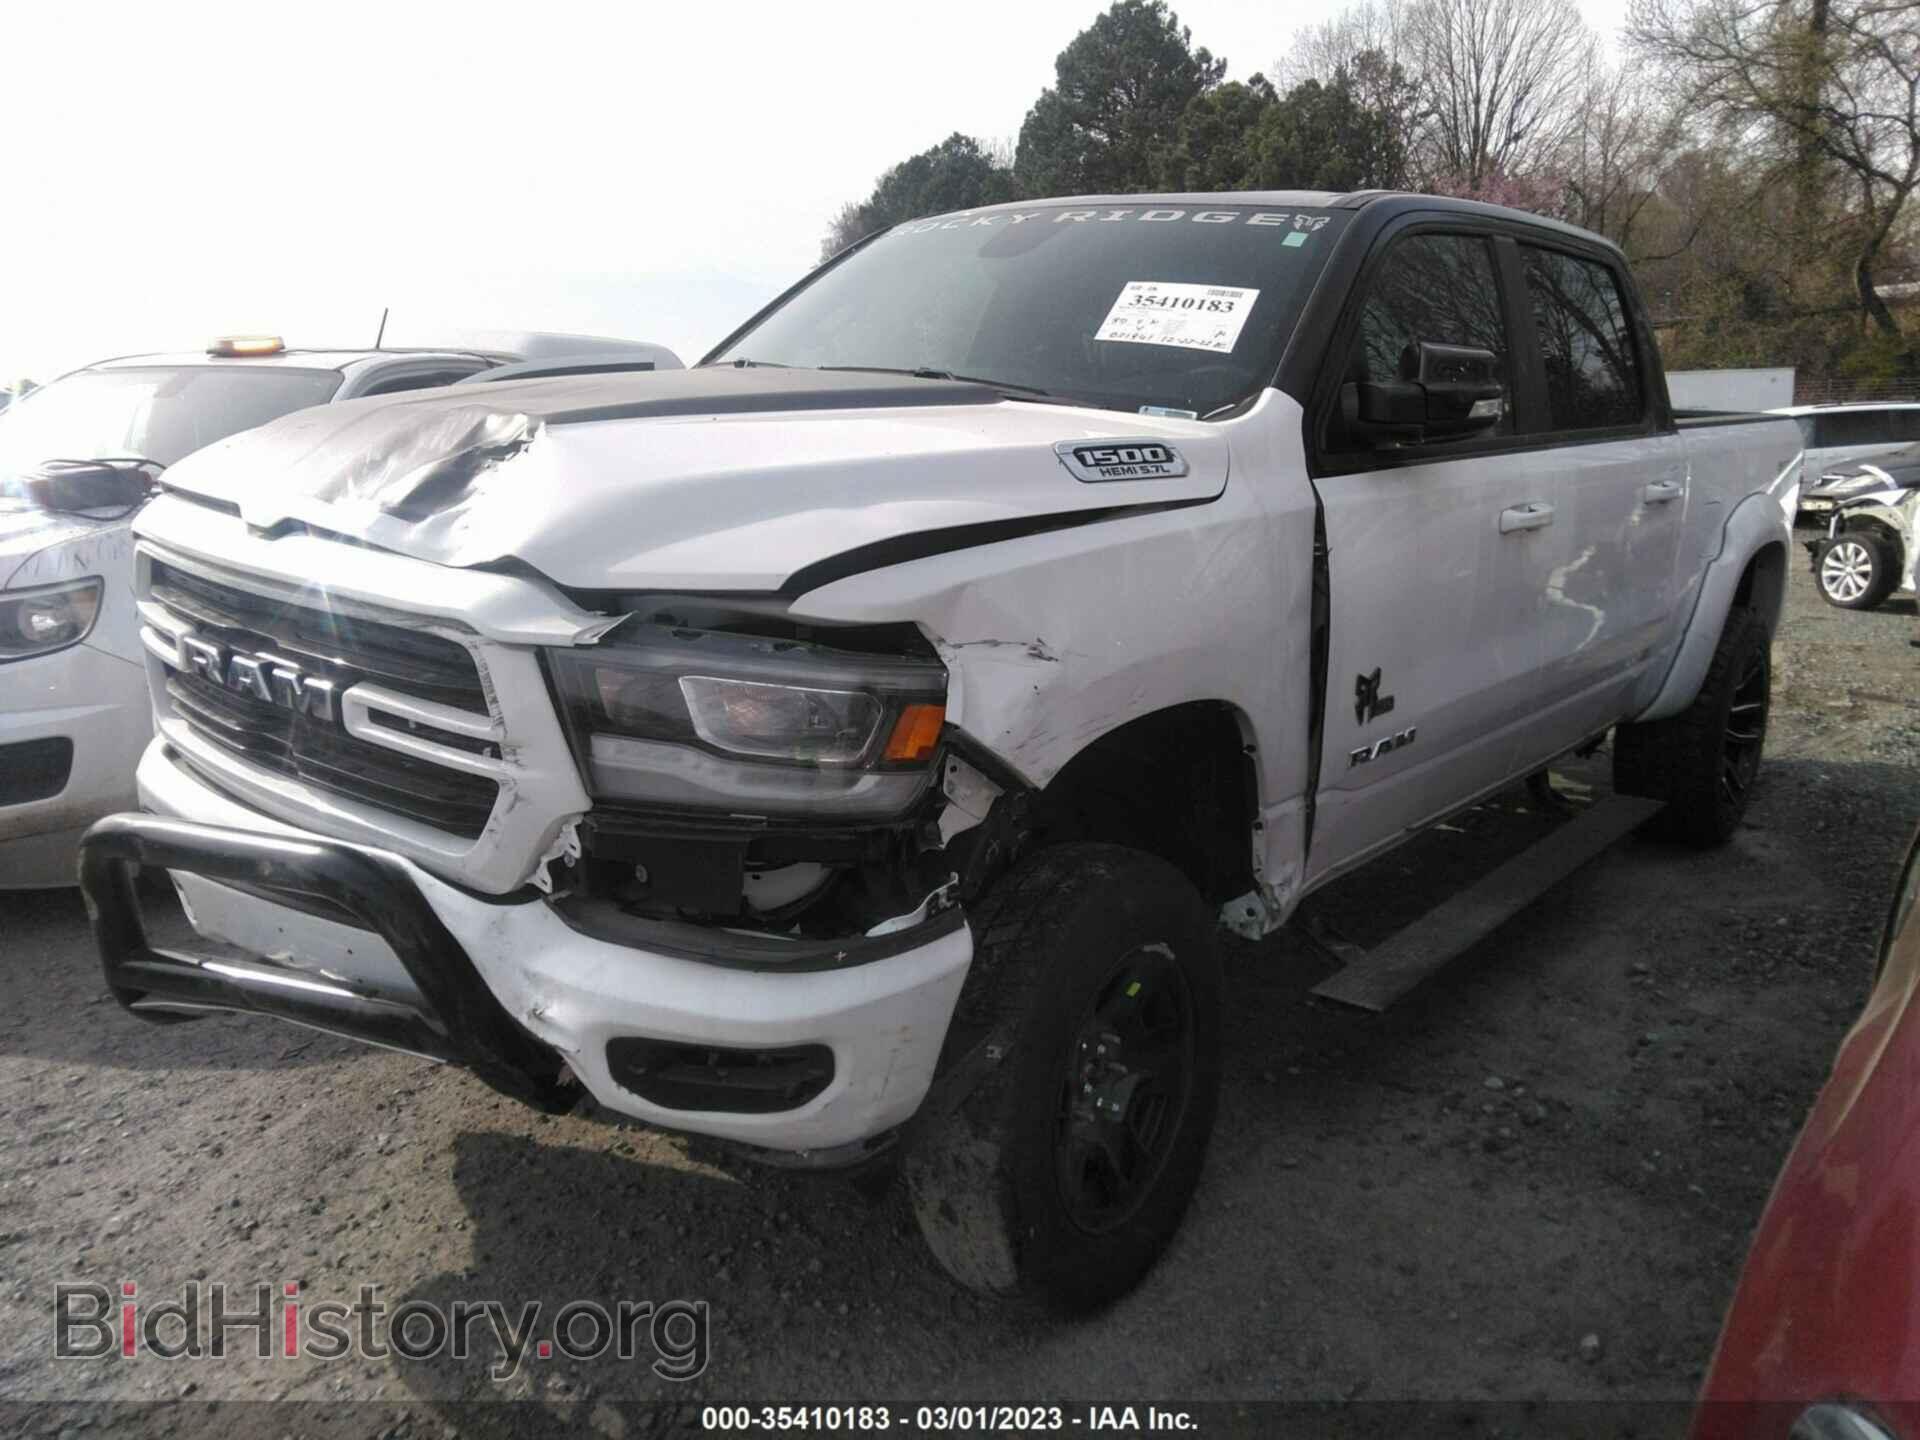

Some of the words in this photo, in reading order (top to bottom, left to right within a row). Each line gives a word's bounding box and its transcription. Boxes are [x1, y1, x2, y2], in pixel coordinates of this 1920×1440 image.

[1053, 210, 1289, 226] RIDGE
[1128, 294, 1234, 313] 35410183
[1078, 447, 1168, 466] 1500
[1099, 465, 1137, 477] HEMI
[1140, 464, 1171, 474] 5.7L
[183, 636, 335, 722] RAM
[1348, 726, 1417, 768] RAM
